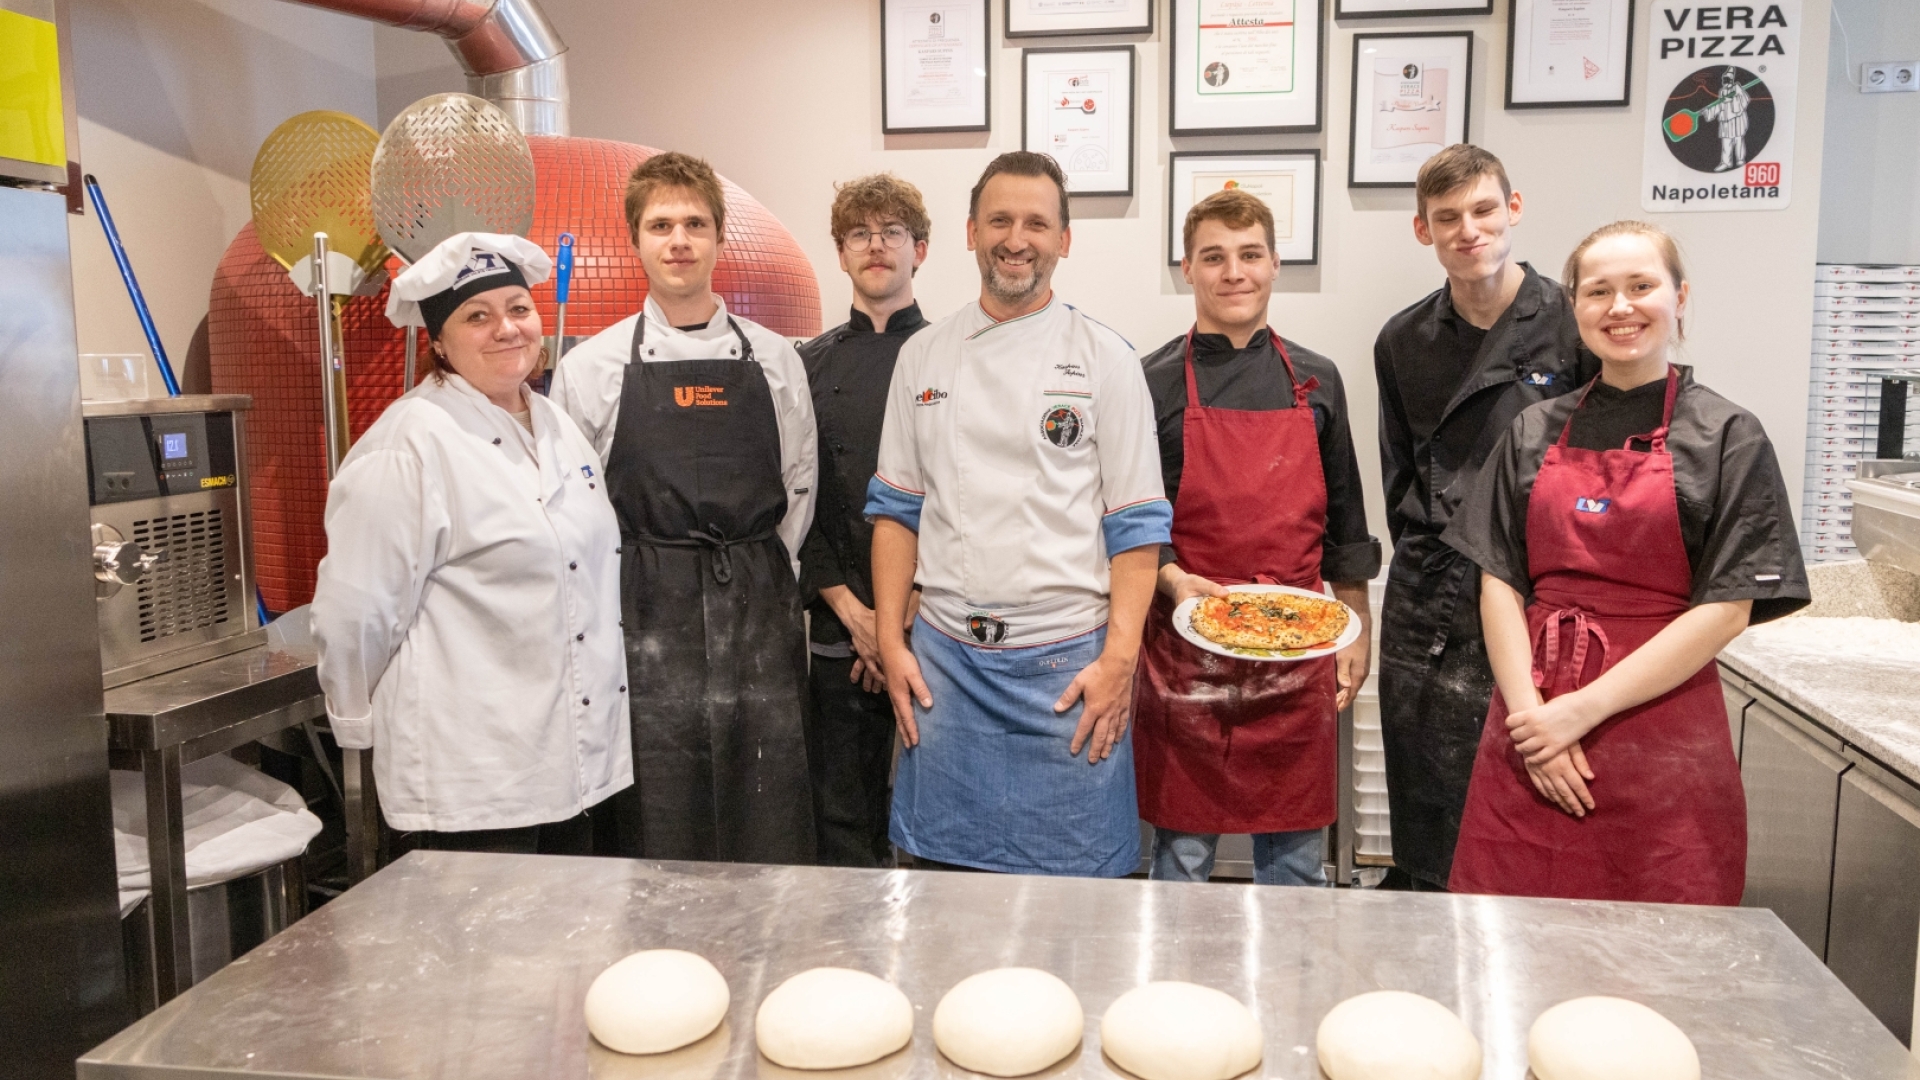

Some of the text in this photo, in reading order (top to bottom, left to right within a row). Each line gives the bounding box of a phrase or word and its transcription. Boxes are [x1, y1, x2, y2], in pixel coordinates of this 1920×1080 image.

[1229, 17, 1264, 27] Attesta
[1664, 5, 1788, 31] VERA
[1660, 34, 1786, 60] PIZZA
[1747, 164, 1778, 184] 960
[1652, 184, 1780, 203] Napoletana
[695, 385, 724, 393] Unilever
[695, 392, 712, 400] Food
[200, 476, 227, 488] ESMACH
